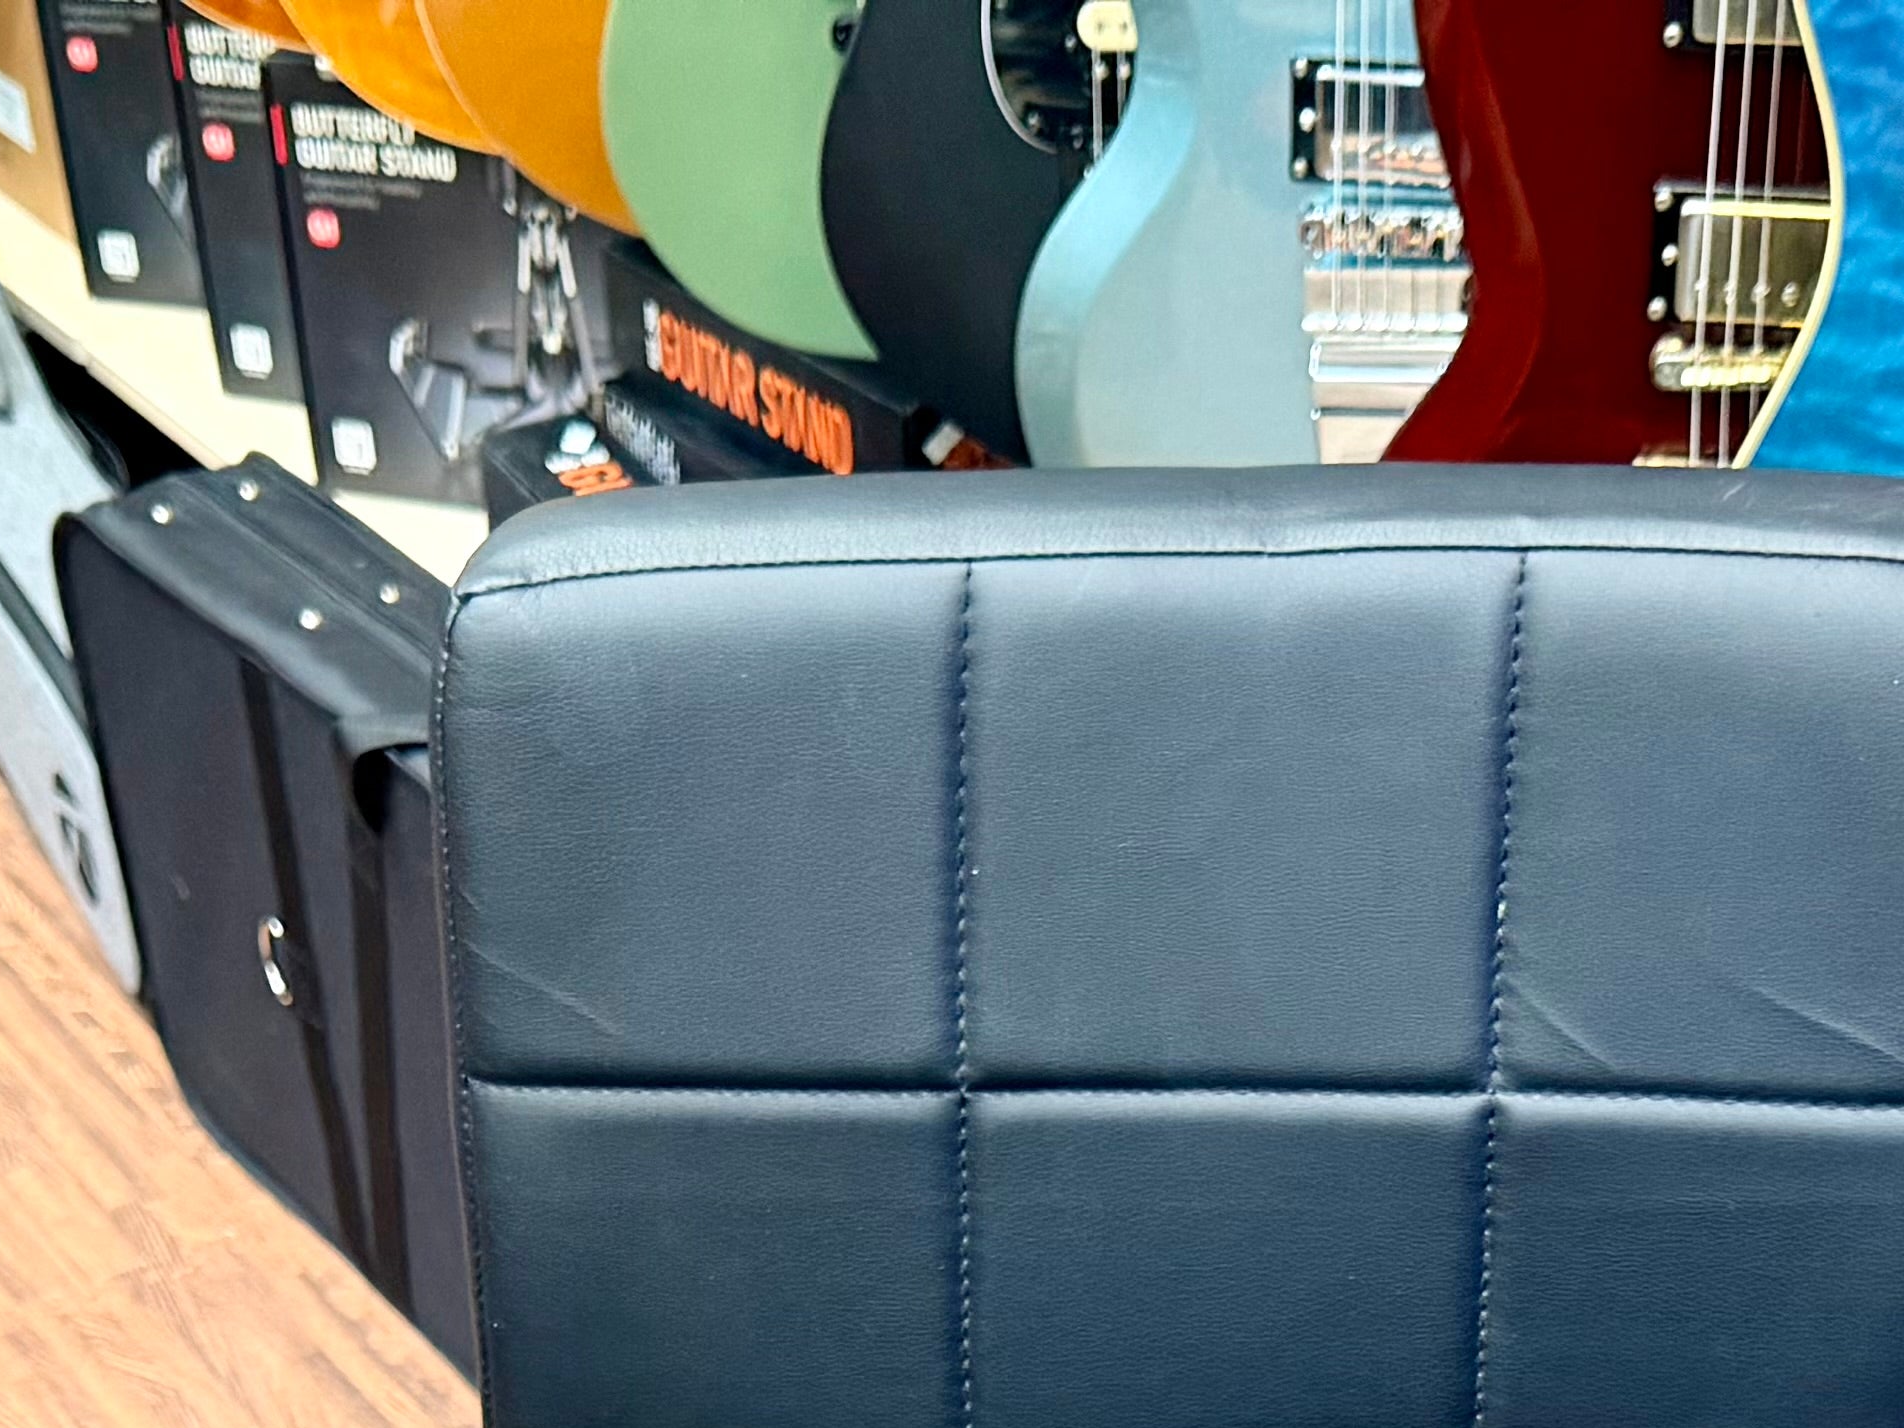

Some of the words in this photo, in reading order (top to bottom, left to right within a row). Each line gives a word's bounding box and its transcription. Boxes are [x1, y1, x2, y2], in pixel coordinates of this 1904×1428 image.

[295, 136, 378, 175] GUITAR
[379, 144, 458, 183] STAND
[659, 308, 759, 427] GUITAR
[758, 364, 854, 476] STAND
